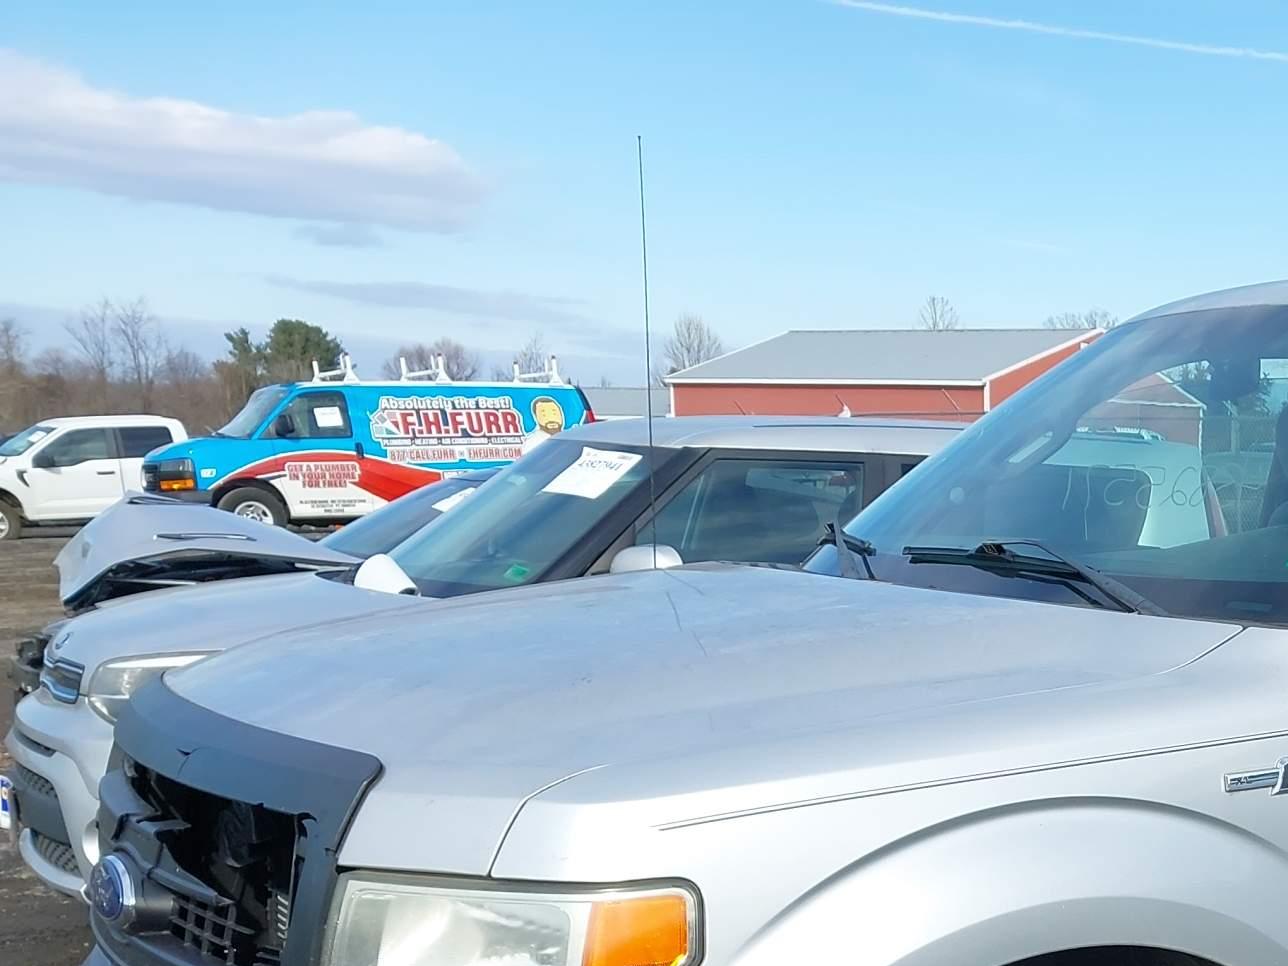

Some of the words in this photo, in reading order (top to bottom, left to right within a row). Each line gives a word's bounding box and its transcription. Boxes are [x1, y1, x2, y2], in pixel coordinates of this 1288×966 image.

[381, 398, 452, 410] Absolutely
[453, 398, 475, 409] the
[478, 398, 510, 409] Best!
[400, 411, 520, 435] F.H.FURR
[287, 464, 303, 472] GET
[306, 464, 312, 472] A
[314, 463, 357, 472] PLUMBER
[302, 472, 327, 480] YOUR
[329, 472, 357, 480] HOME
[303, 480, 320, 488] FOR
